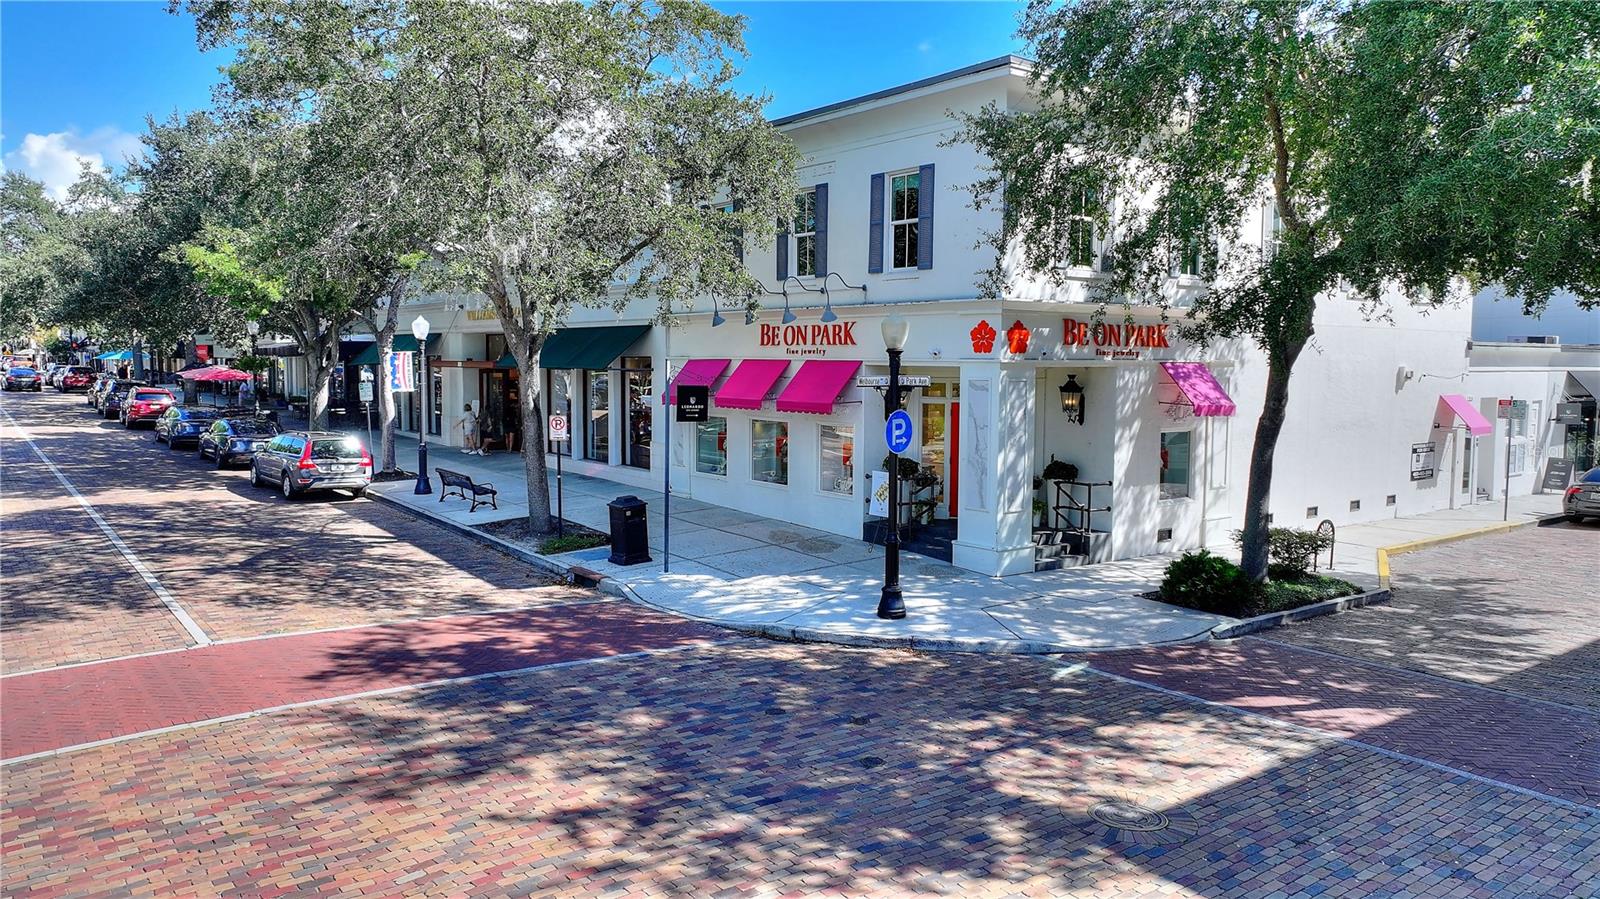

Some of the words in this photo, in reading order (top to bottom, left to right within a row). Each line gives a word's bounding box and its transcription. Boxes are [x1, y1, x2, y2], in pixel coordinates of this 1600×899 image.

[760, 323, 781, 346] BE
[783, 324, 808, 346] ON
[810, 321, 857, 346] PARK
[1062, 318, 1089, 347] BE
[1093, 321, 1121, 347] ON
[1124, 323, 1170, 348] PARK
[786, 347, 799, 355] fine
[800, 347, 826, 357] jewelry
[1096, 348, 1110, 356] fine
[1112, 348, 1140, 358] jewelry
